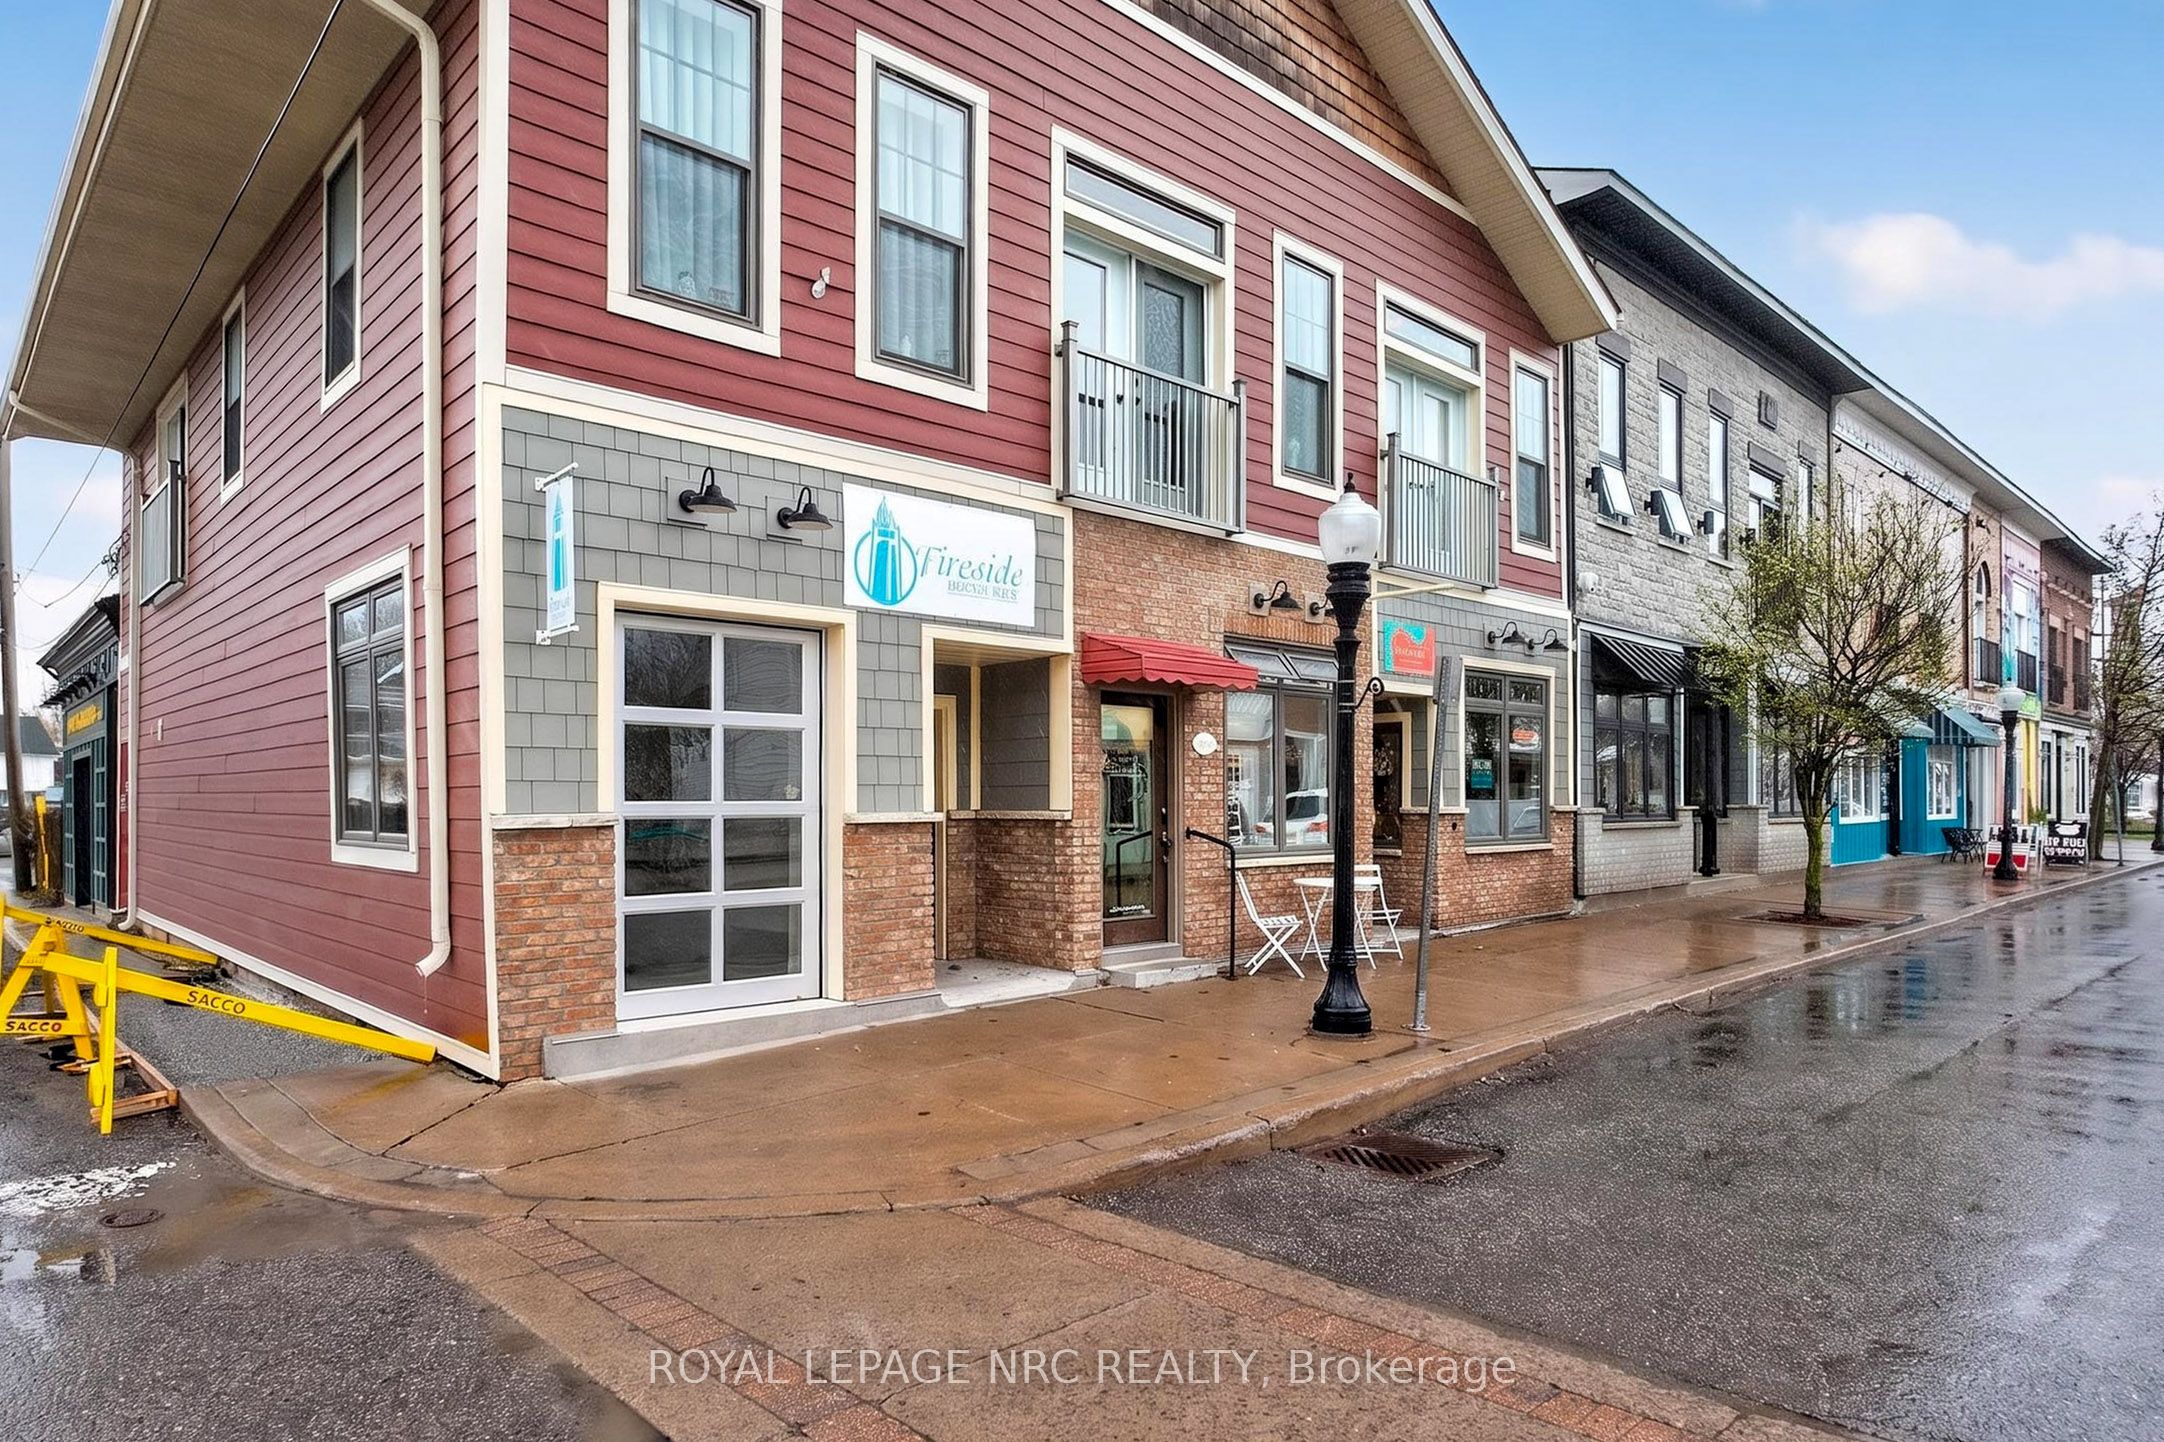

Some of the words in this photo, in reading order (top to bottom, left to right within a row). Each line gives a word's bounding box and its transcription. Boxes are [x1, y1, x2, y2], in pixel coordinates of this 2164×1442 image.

[916, 545, 1023, 587] Fireside
[187, 990, 246, 1014] SACCO
[5, 1020, 62, 1032] SACCO
